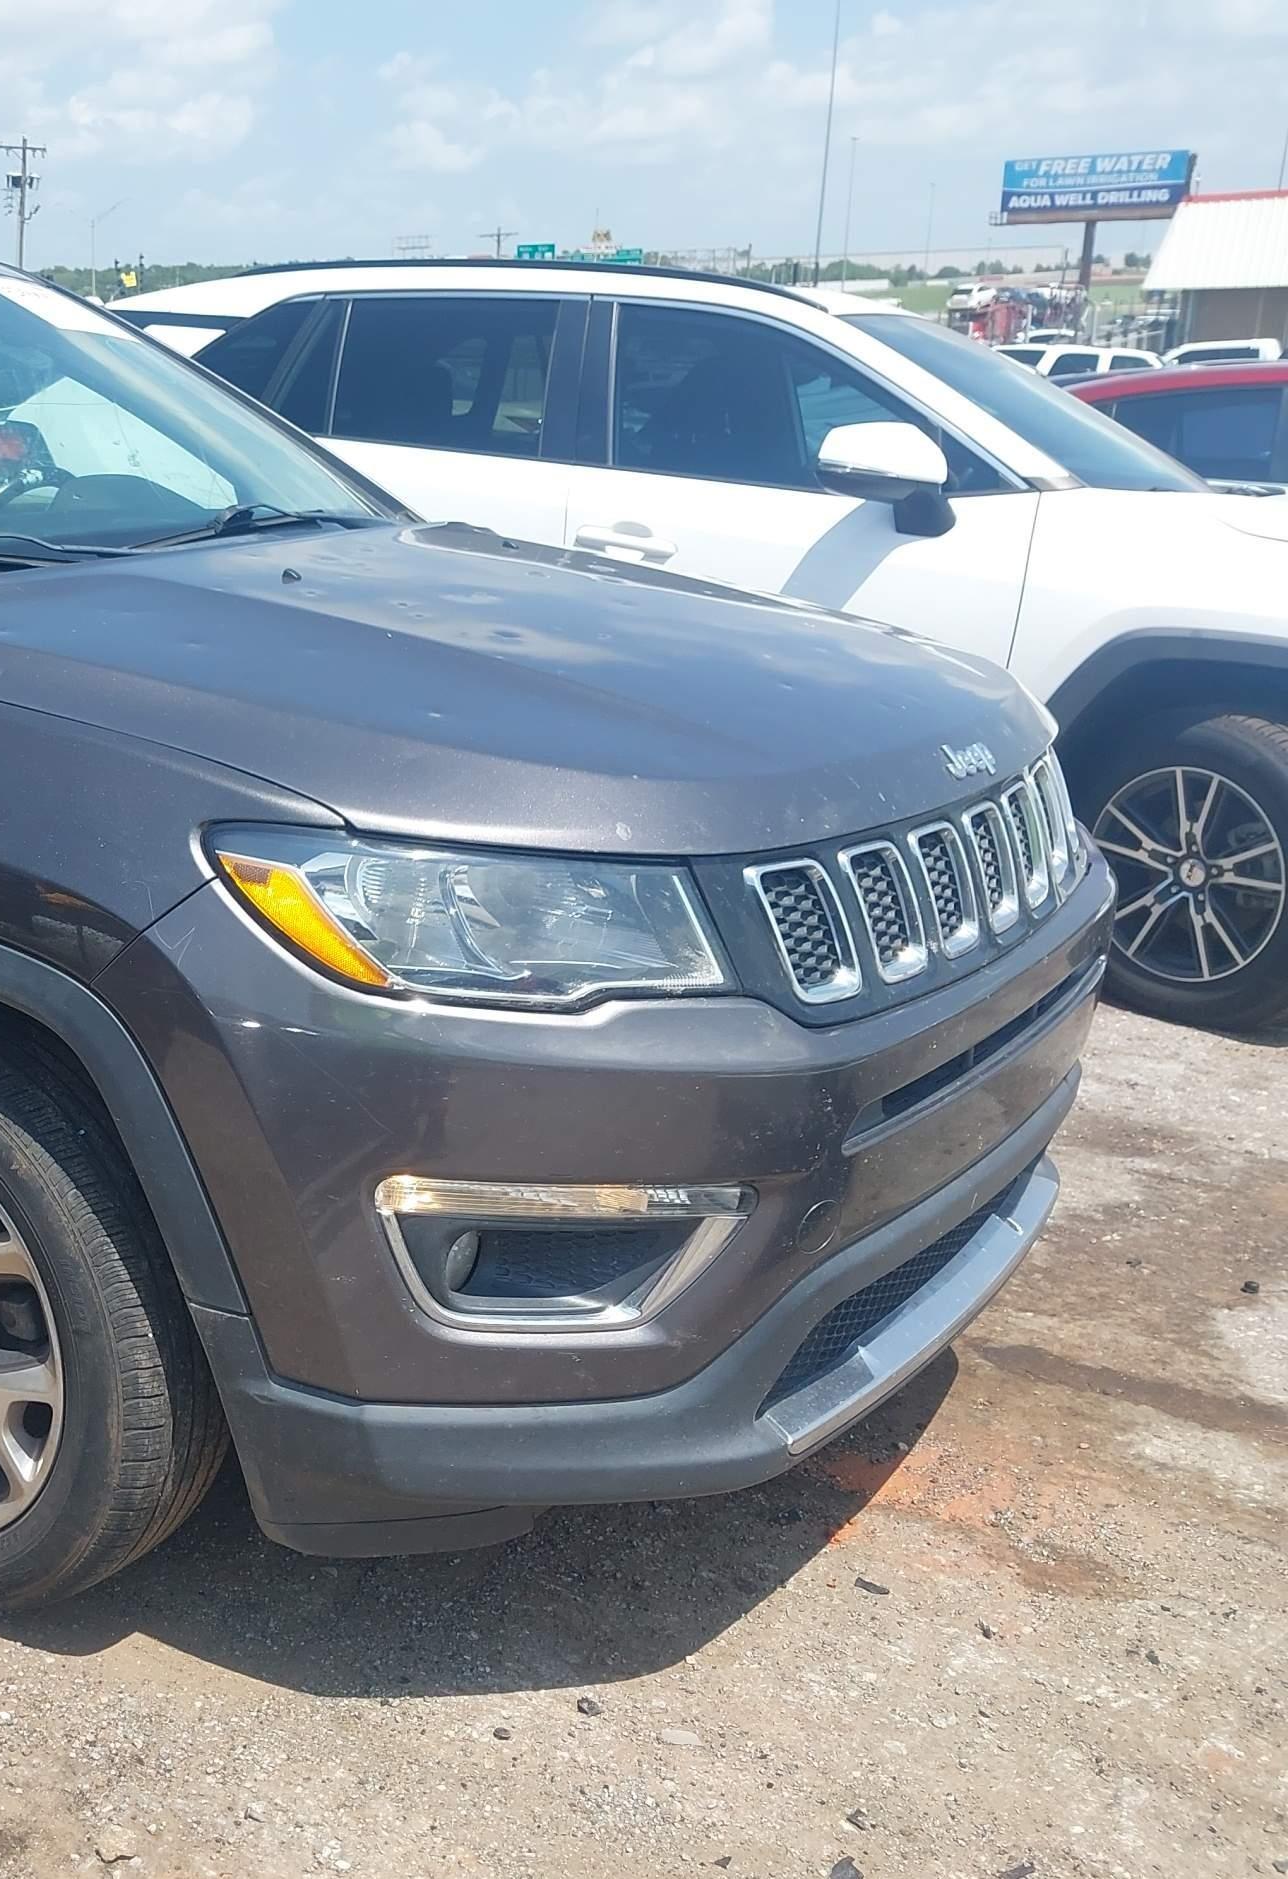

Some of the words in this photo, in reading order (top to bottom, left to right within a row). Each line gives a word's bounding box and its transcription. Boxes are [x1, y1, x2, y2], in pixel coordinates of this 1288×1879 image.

[1015, 160, 1037, 171] GET
[1038, 157, 1093, 176] FREE
[1096, 153, 1172, 173] WATER
[1023, 177, 1047, 188] FOR
[1049, 175, 1086, 186] LAWN
[1008, 195, 1051, 209] AQUA
[1054, 192, 1094, 206] WELL
[1097, 190, 1170, 204] DRILLING
[940, 742, 997, 780] Jeep
